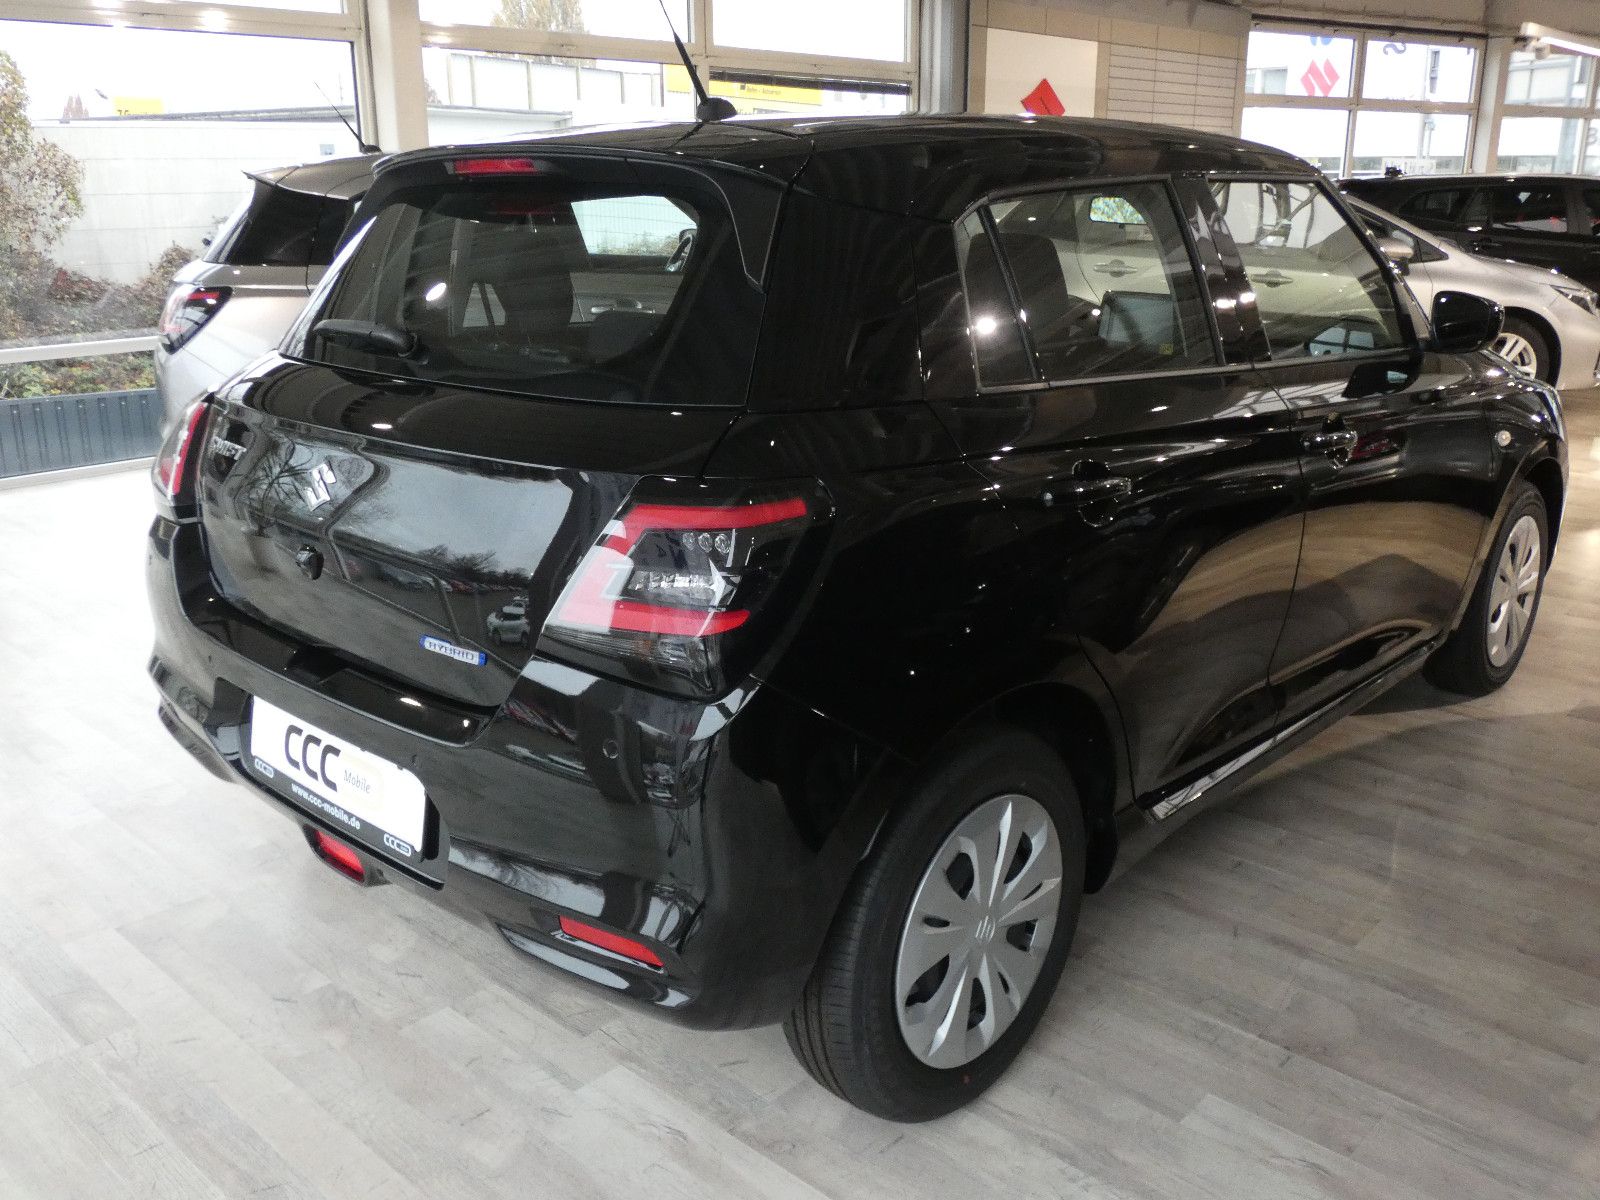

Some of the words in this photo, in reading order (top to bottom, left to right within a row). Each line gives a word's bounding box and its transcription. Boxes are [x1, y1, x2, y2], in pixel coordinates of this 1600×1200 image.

[428, 641, 474, 661] HYBRID
[285, 724, 341, 792] CCC
[344, 769, 371, 794] Mobile
[291, 783, 361, 830] www.ccc-mobile.de
